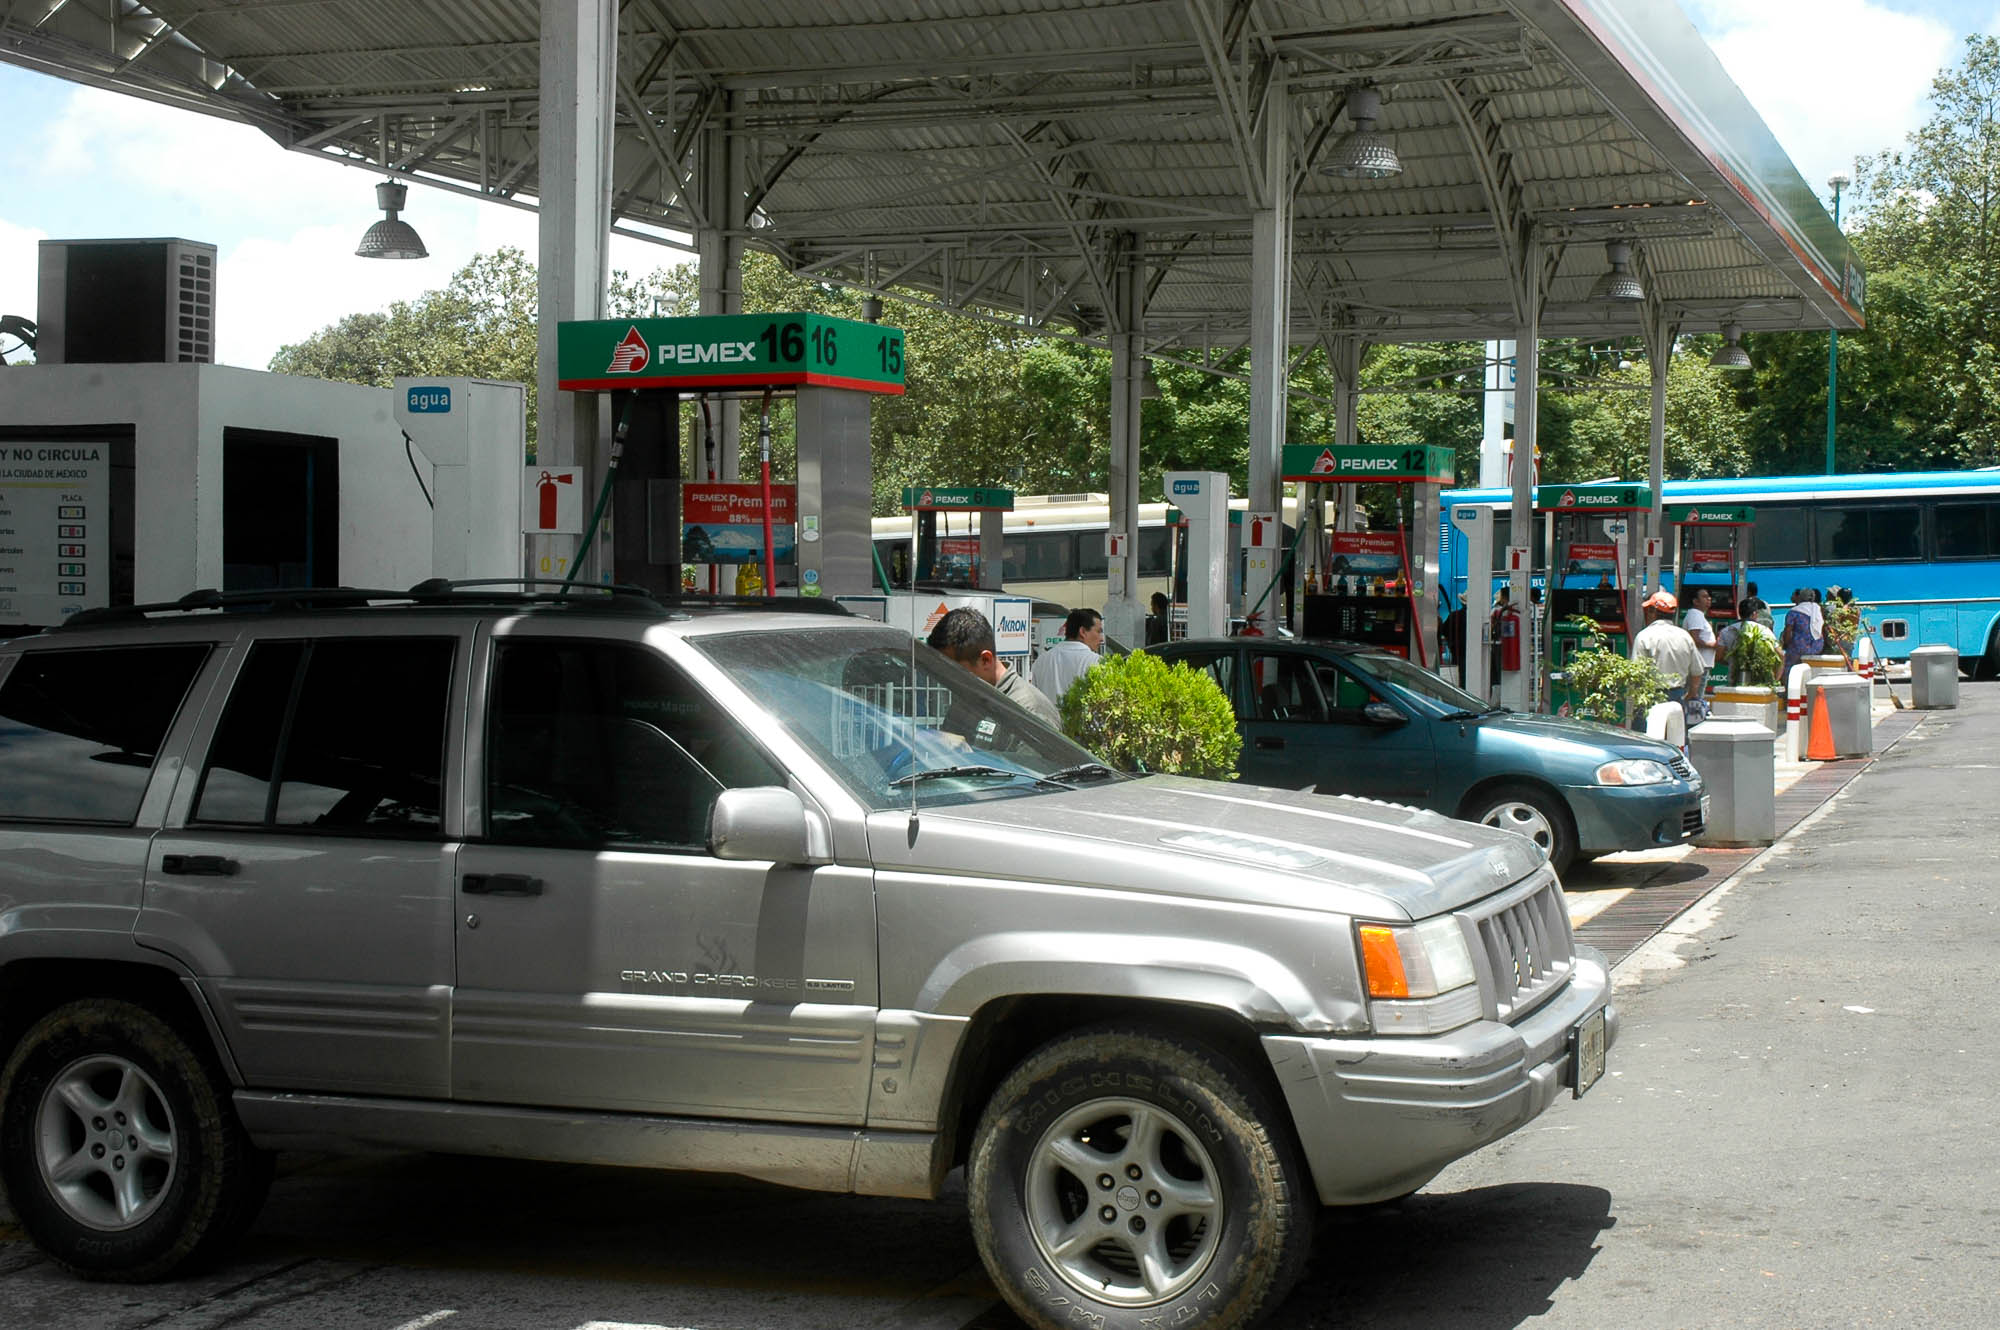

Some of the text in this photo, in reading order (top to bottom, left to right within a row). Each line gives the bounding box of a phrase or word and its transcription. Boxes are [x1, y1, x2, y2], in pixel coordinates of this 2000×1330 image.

[760, 322, 805, 364] 16
[811, 325, 838, 366] 16
[658, 341, 756, 364] PEMEX
[877, 335, 900, 375] 15
[410, 394, 449, 410] agua
[13, 449, 33, 461] NO
[38, 449, 100, 461] CIRCULA
[1401, 450, 1425, 470] 12
[1341, 459, 1398, 470] PEMEX
[2, 469, 12, 478] LA
[14, 469, 43, 478] CIUDAD
[45, 470, 55, 478] DE
[1174, 483, 1199, 493] agua
[692, 494, 787, 508] PEMEX Premum
[935, 496, 968, 504] PEMEX
[1578, 496, 1618, 504] PEMEX
[1624, 490, 1635, 504] 8
[1361, 537, 1395, 546] Premium
[997, 616, 1027, 632] AKRON
[621, 970, 799, 990] GRAND CHEROKEE
[1014, 1072, 1223, 1143] MICHELIN
